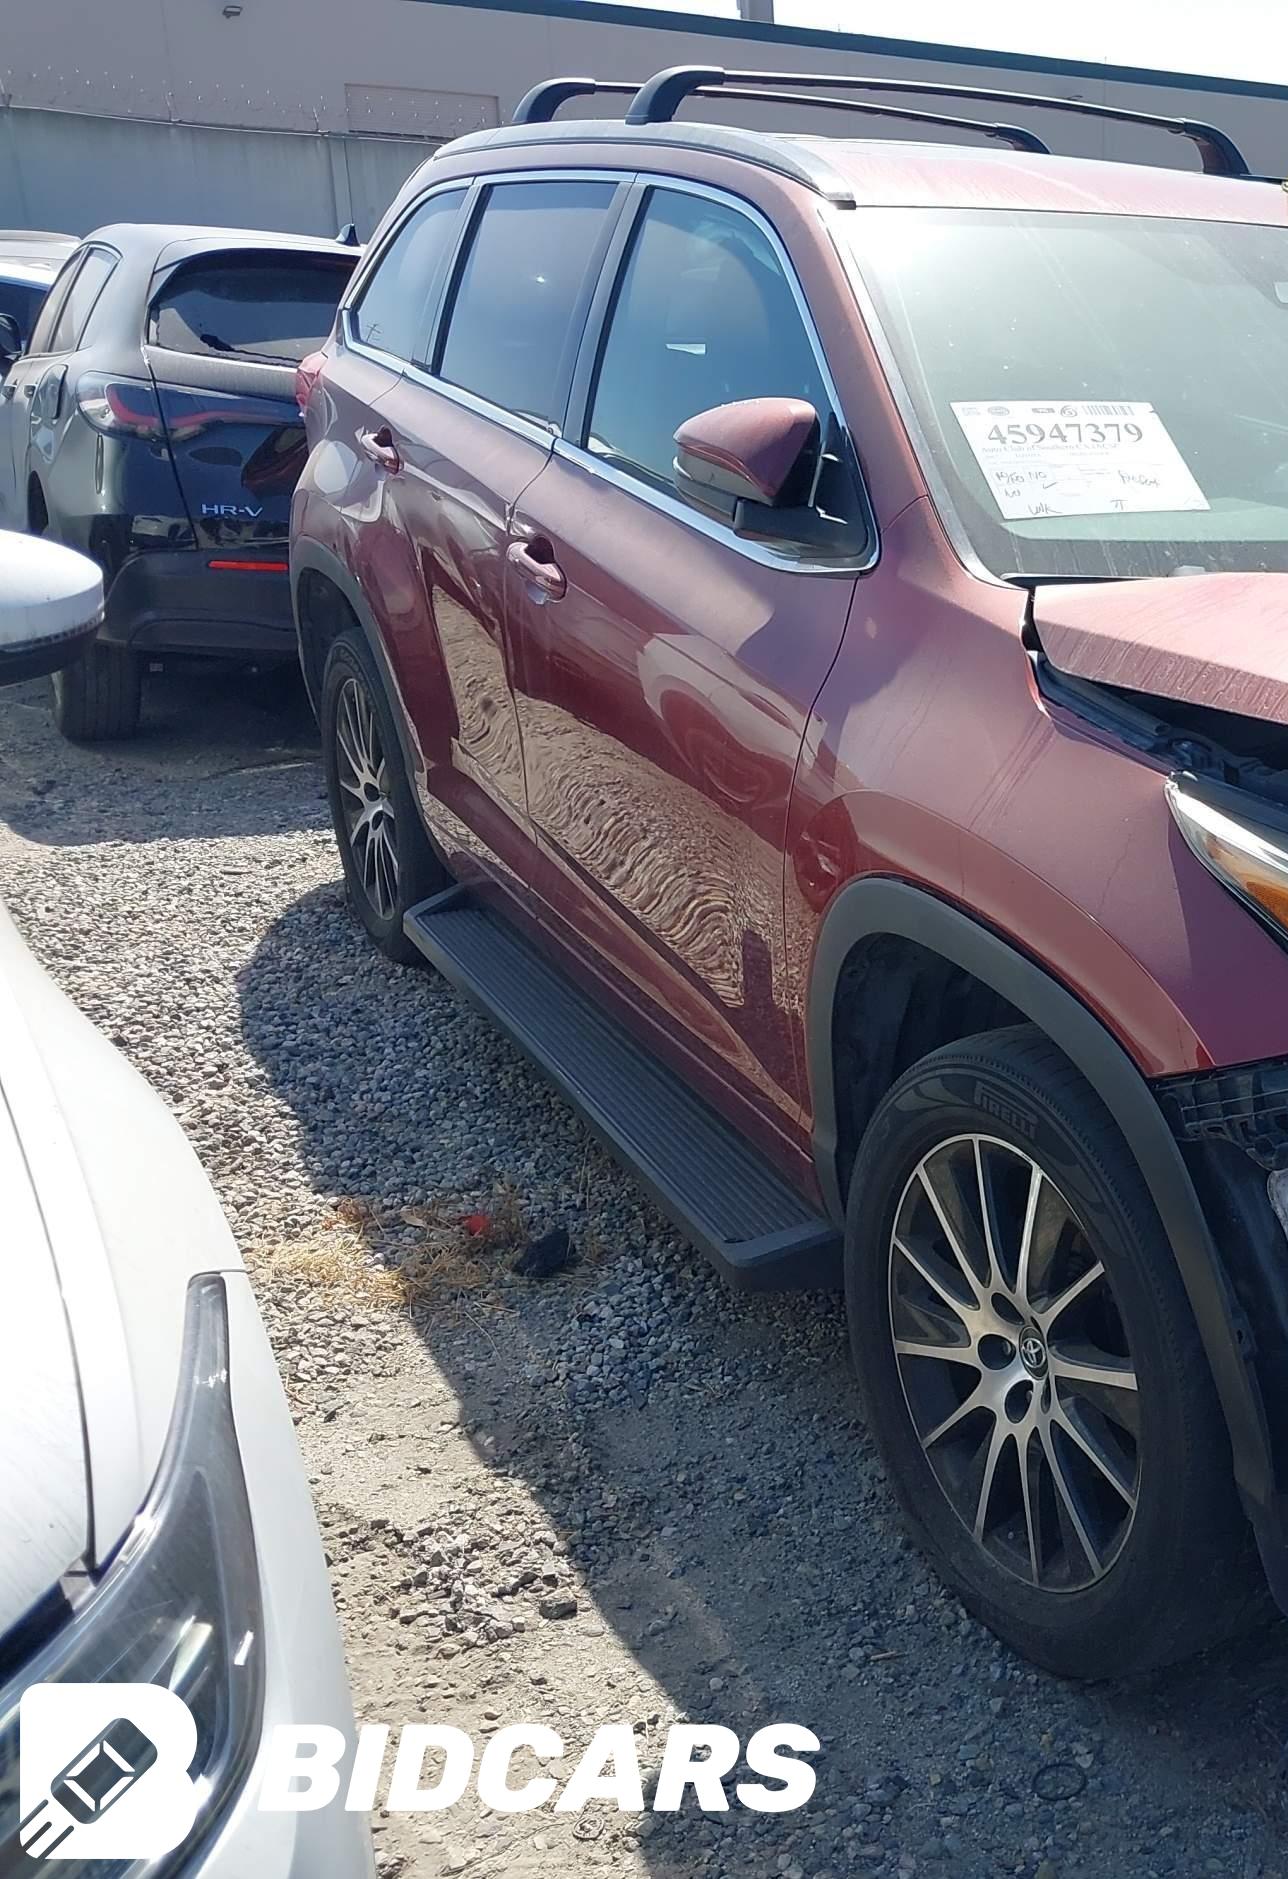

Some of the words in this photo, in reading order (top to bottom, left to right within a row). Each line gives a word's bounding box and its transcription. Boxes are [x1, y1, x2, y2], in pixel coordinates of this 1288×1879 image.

[987, 423, 1143, 444] 45947379
[202, 504, 263, 517] HR-V
[974, 1080, 1040, 1139] PIRELLI
